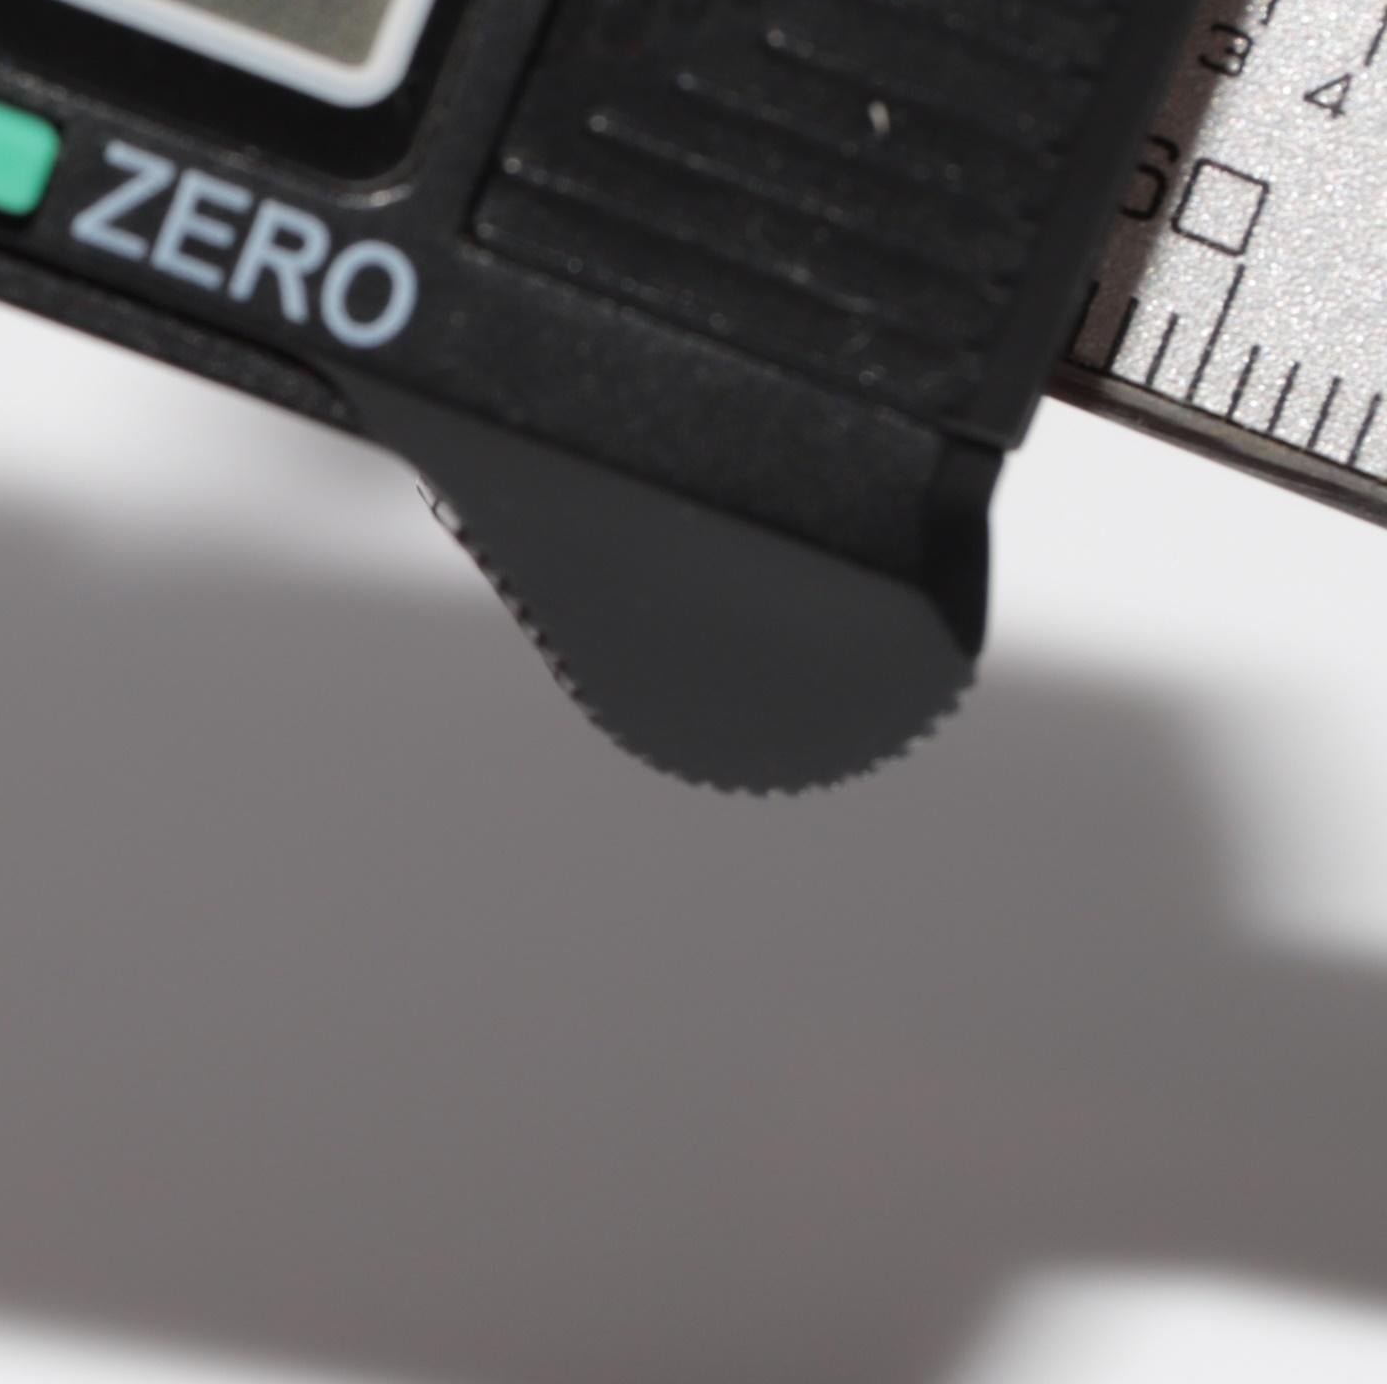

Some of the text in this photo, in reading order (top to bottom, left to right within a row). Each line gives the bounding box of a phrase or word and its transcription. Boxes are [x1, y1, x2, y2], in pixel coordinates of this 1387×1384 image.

[1197, 23, 1353, 119] 3 4
[70, 140, 419, 349] ZERO
